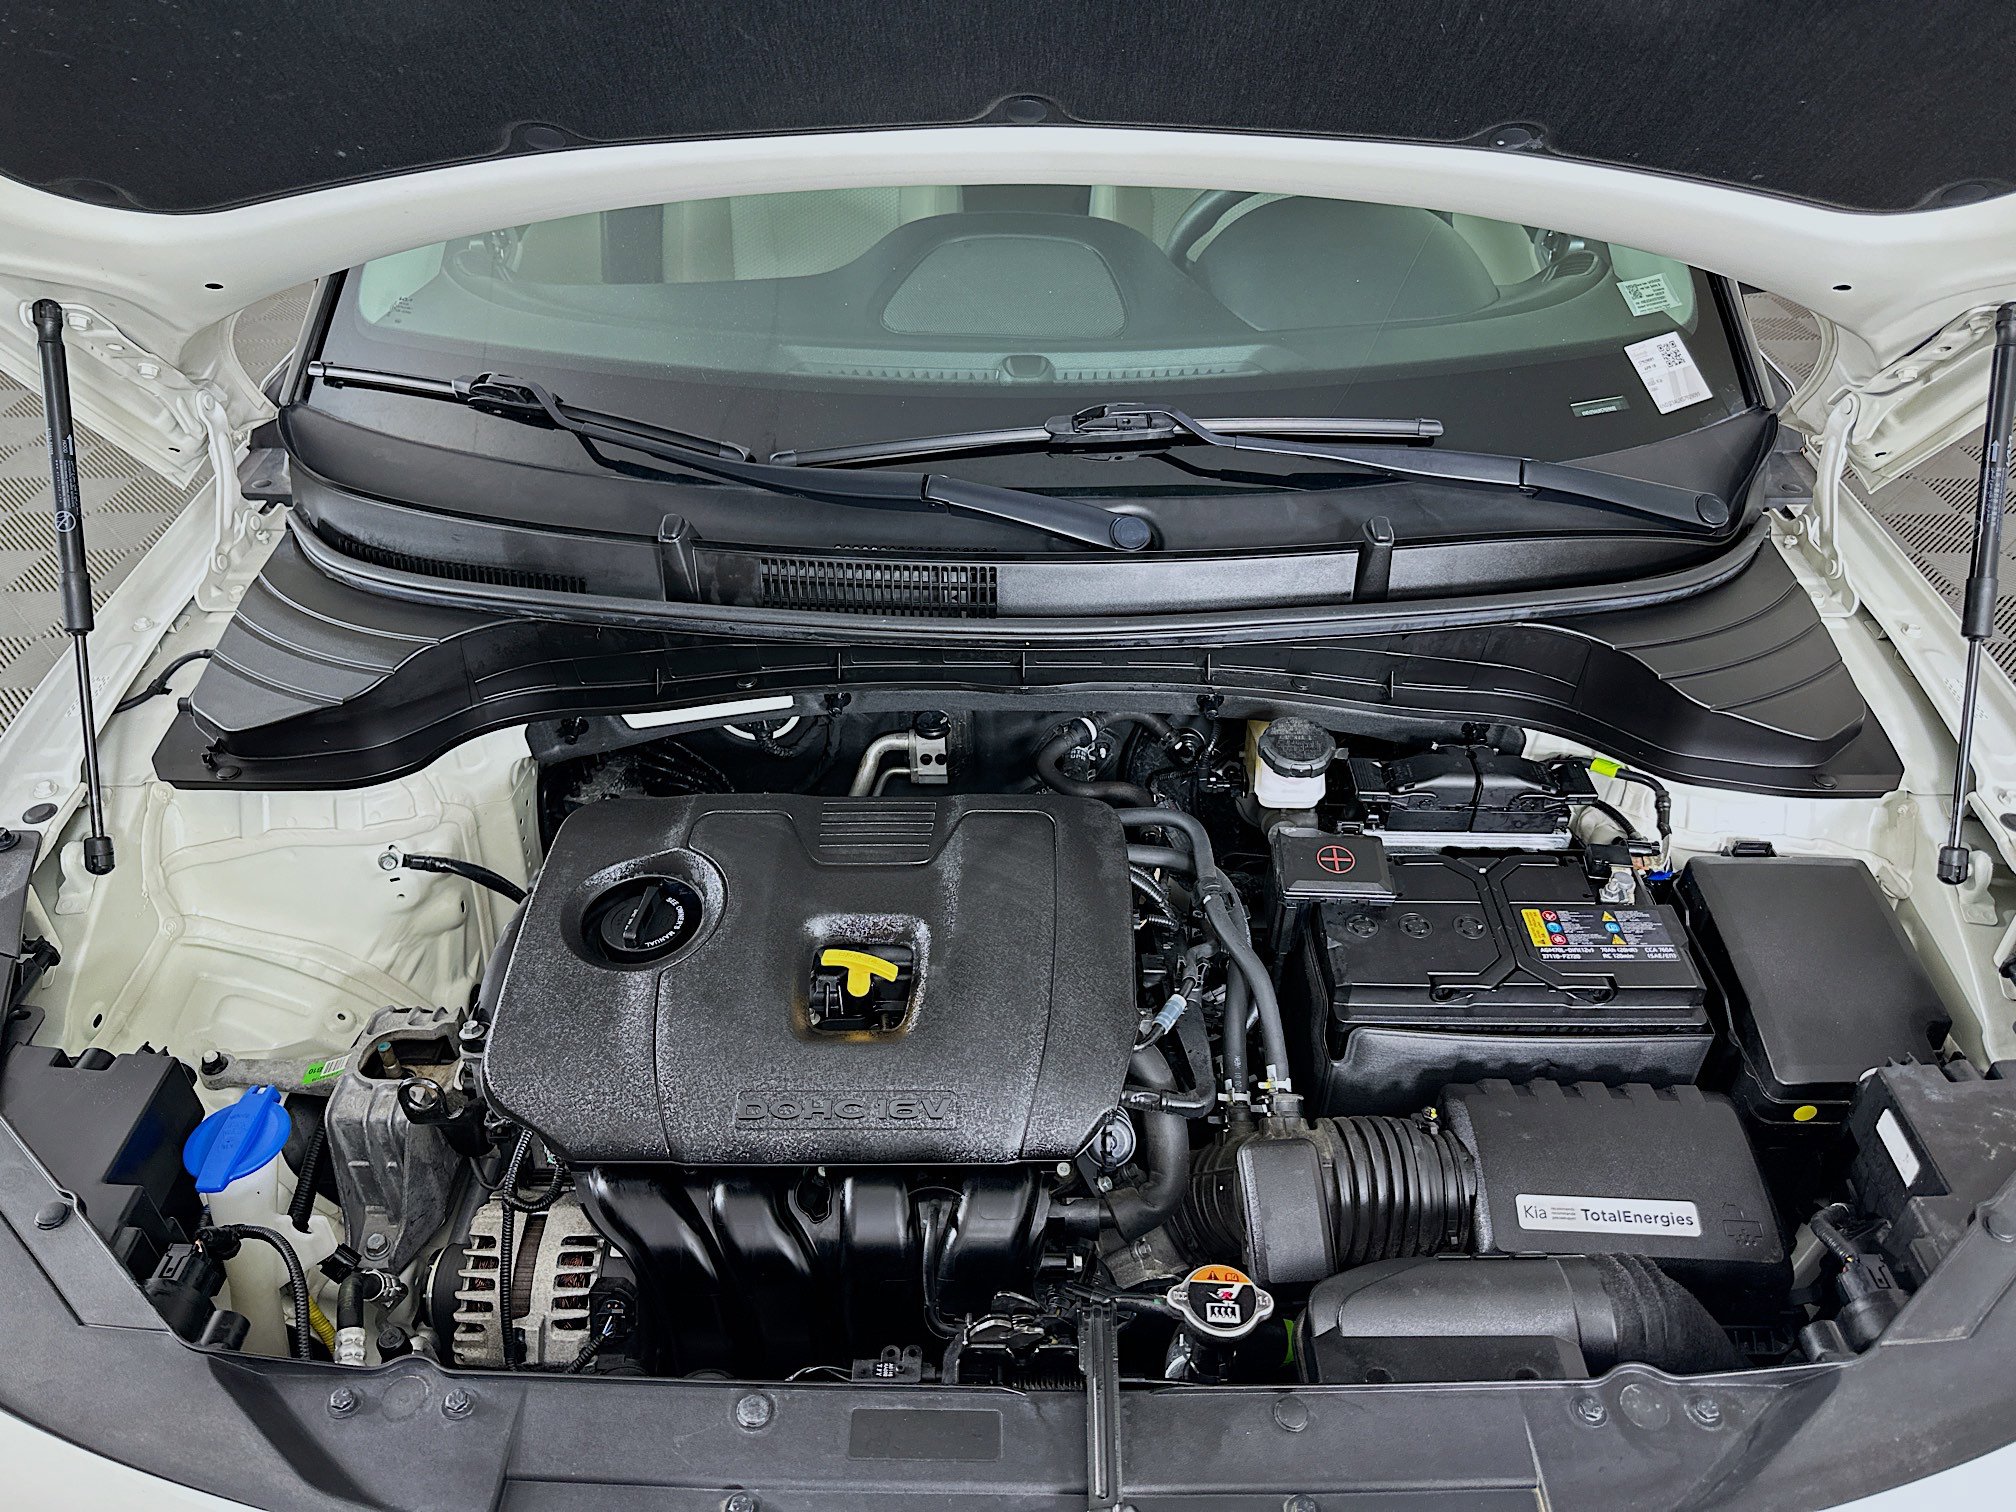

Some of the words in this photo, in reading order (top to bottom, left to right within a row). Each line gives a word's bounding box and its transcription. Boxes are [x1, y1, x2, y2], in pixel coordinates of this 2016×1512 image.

[666, 896, 679, 907] SEE
[644, 930, 676, 948] MANUAL
[737, 1098, 867, 1120] DOHC
[876, 1098, 953, 1120] 16V
[1523, 1204, 1548, 1220] Kia
[1580, 1208, 1694, 1227] TotalEnergies
